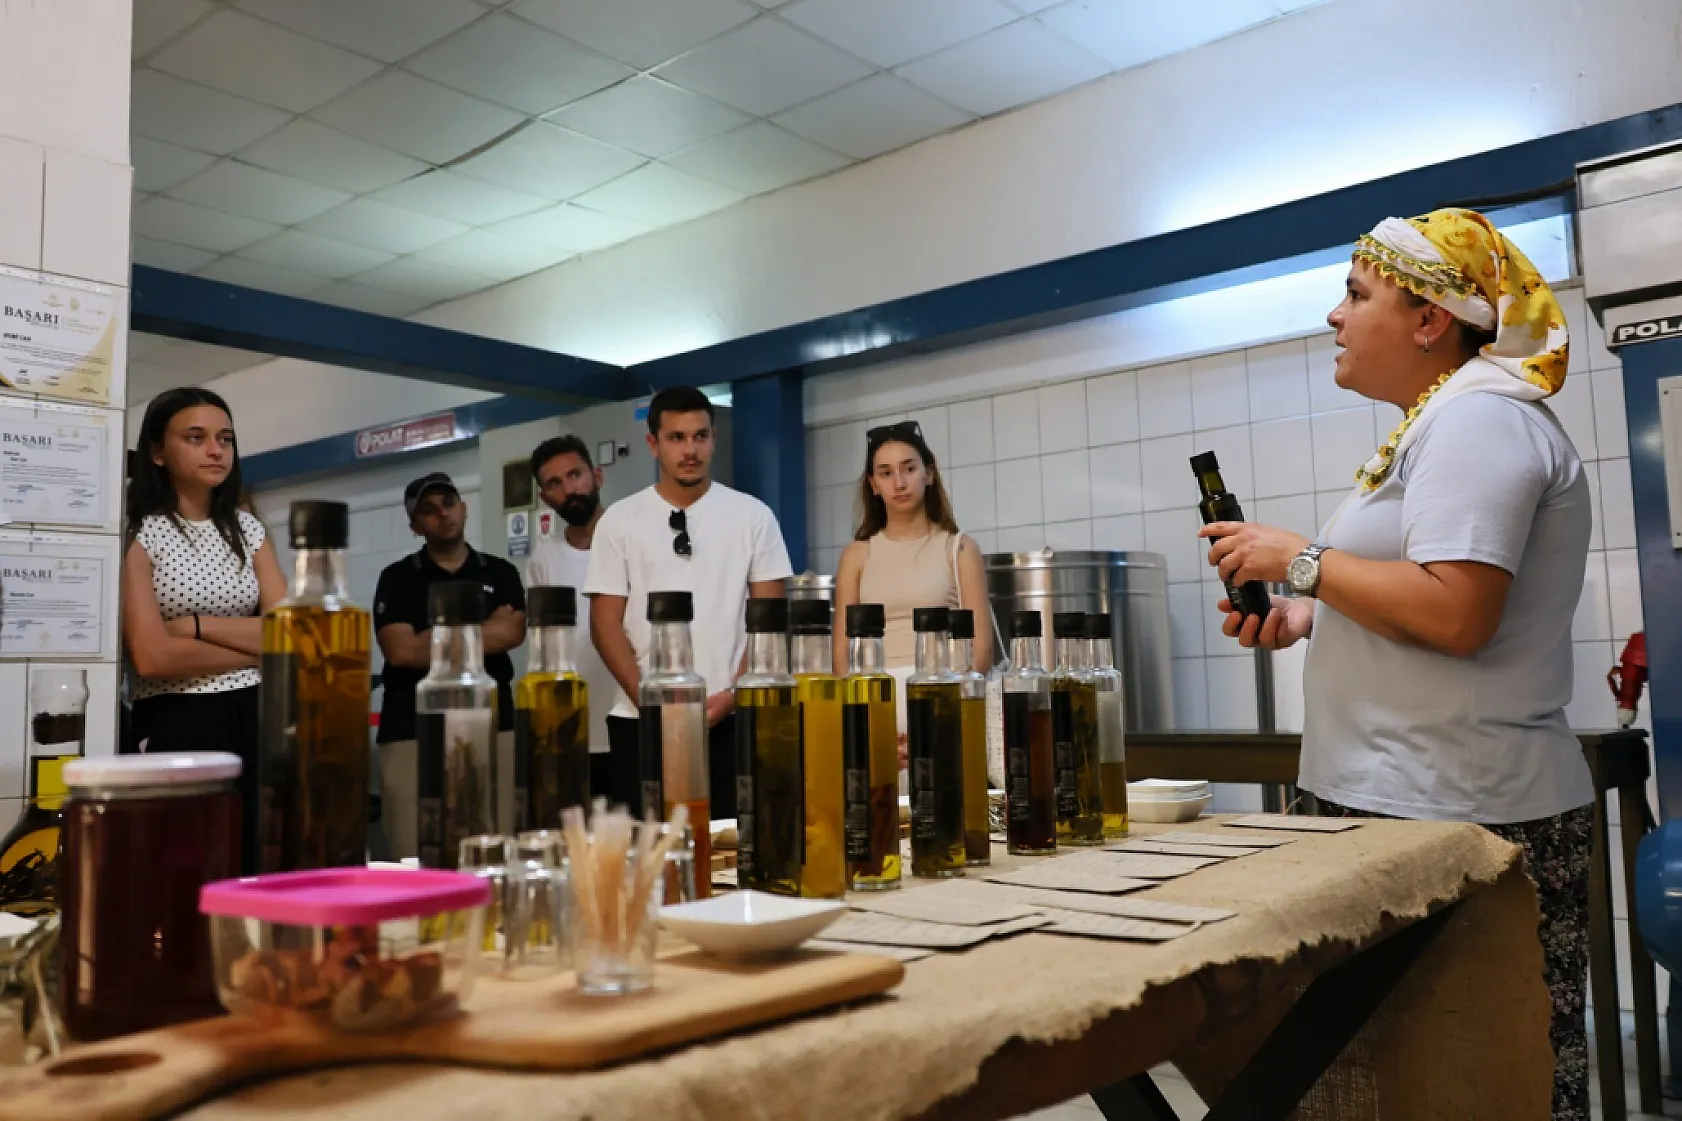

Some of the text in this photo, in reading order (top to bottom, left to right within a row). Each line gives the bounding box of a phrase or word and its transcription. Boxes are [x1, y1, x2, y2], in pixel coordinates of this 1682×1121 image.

[4, 305, 60, 324] BAŞARI
[1619, 319, 1682, 341] POL
[2, 432, 52, 446] BAŞARI
[3, 568, 52, 580] BAŞARI
